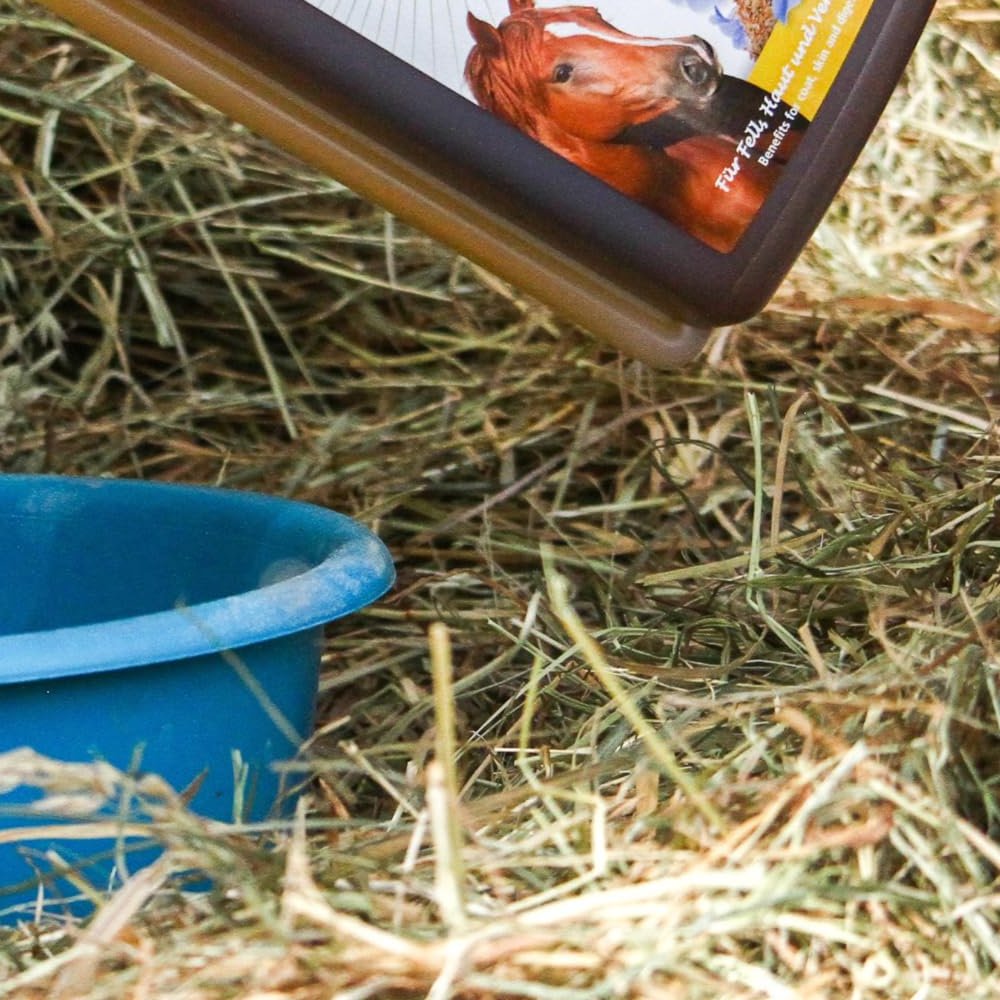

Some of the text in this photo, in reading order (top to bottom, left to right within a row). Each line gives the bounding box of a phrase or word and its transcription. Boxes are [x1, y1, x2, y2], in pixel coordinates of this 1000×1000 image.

[714, 156, 741, 193] Für
[759, 64, 796, 117] Haut
[791, 22, 817, 68] und
[757, 120, 791, 167] Benefits
[784, 103, 802, 121] for
[813, 48, 830, 72] skin
[826, 23, 842, 49] and
